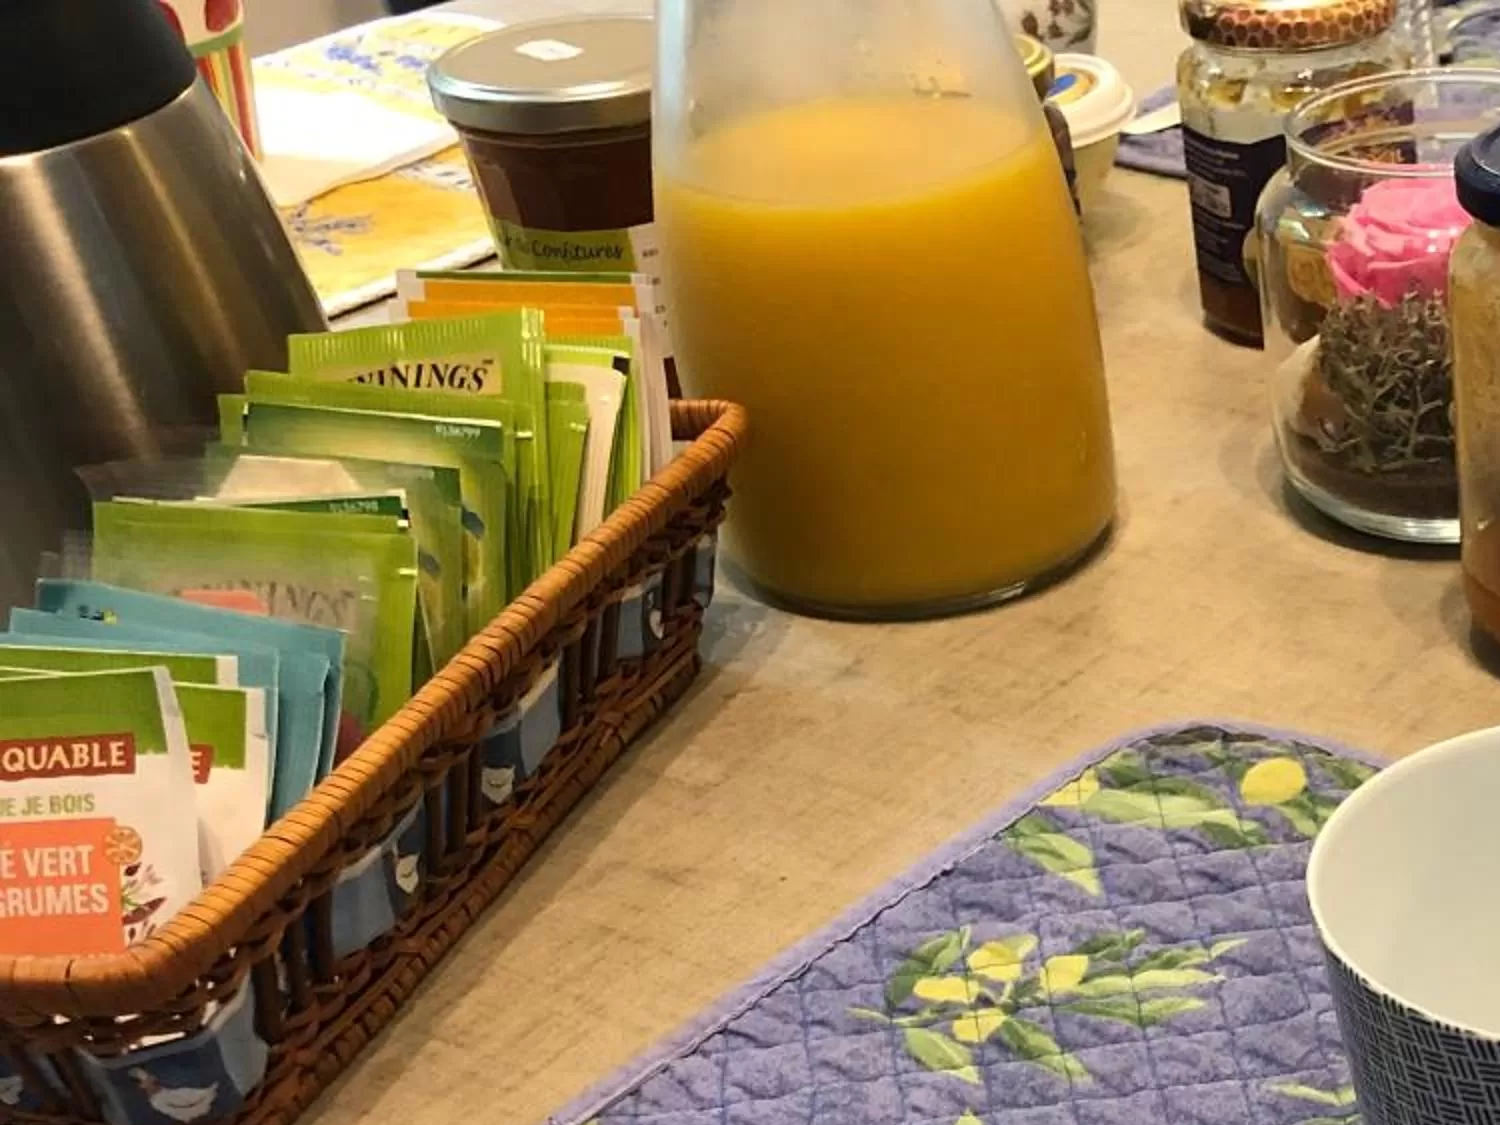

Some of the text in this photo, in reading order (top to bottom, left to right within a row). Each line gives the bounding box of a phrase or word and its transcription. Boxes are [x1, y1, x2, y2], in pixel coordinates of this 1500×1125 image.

[347, 363, 488, 393] ININGS
[2, 741, 127, 773] QUABLE
[21, 795, 46, 816] JE
[50, 793, 95, 815] BOIS
[23, 844, 95, 877] VERT
[0, 883, 109, 918] RUMES
